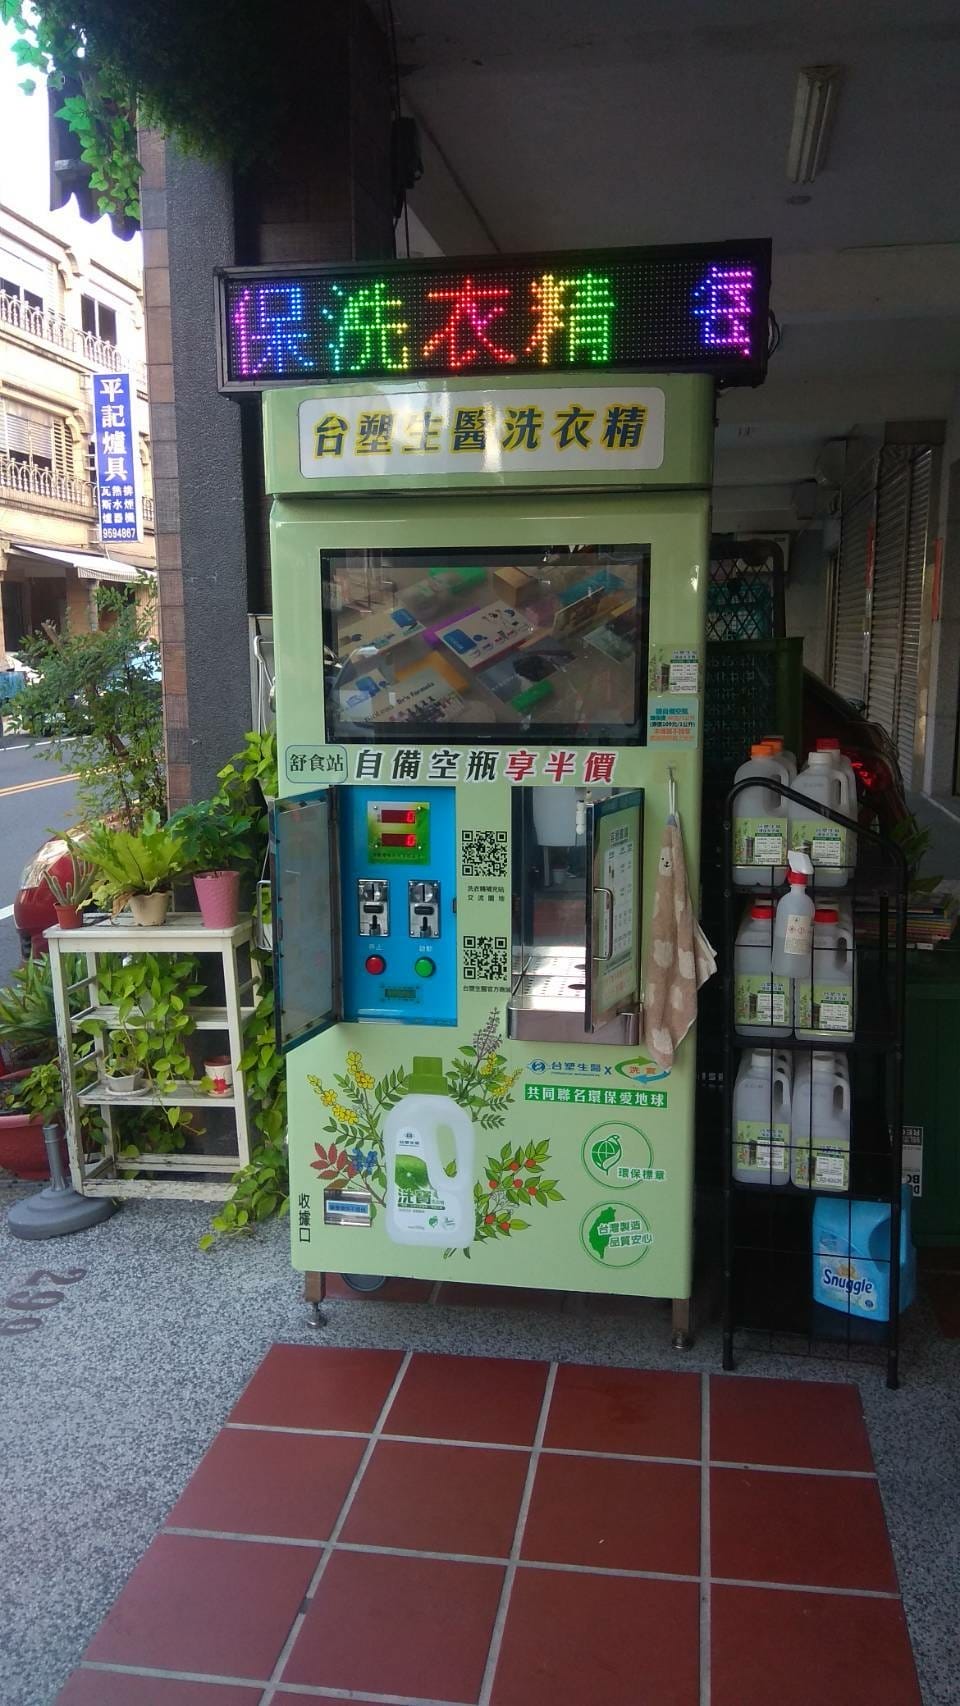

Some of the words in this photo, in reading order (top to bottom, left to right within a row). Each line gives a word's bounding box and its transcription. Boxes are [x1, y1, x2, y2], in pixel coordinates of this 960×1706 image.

[314, 404, 648, 459] 台塑生醫洗衣精
[289, 752, 344, 773] 舒食站
[355, 749, 618, 785] 自備空瓶享半價
[527, 1086, 664, 1107] 共同聯名環保愛地球
[618, 1167, 664, 1180] 環保標章
[609, 1234, 652, 1248] 品質安心
[823, 1269, 874, 1296] Snuggle
